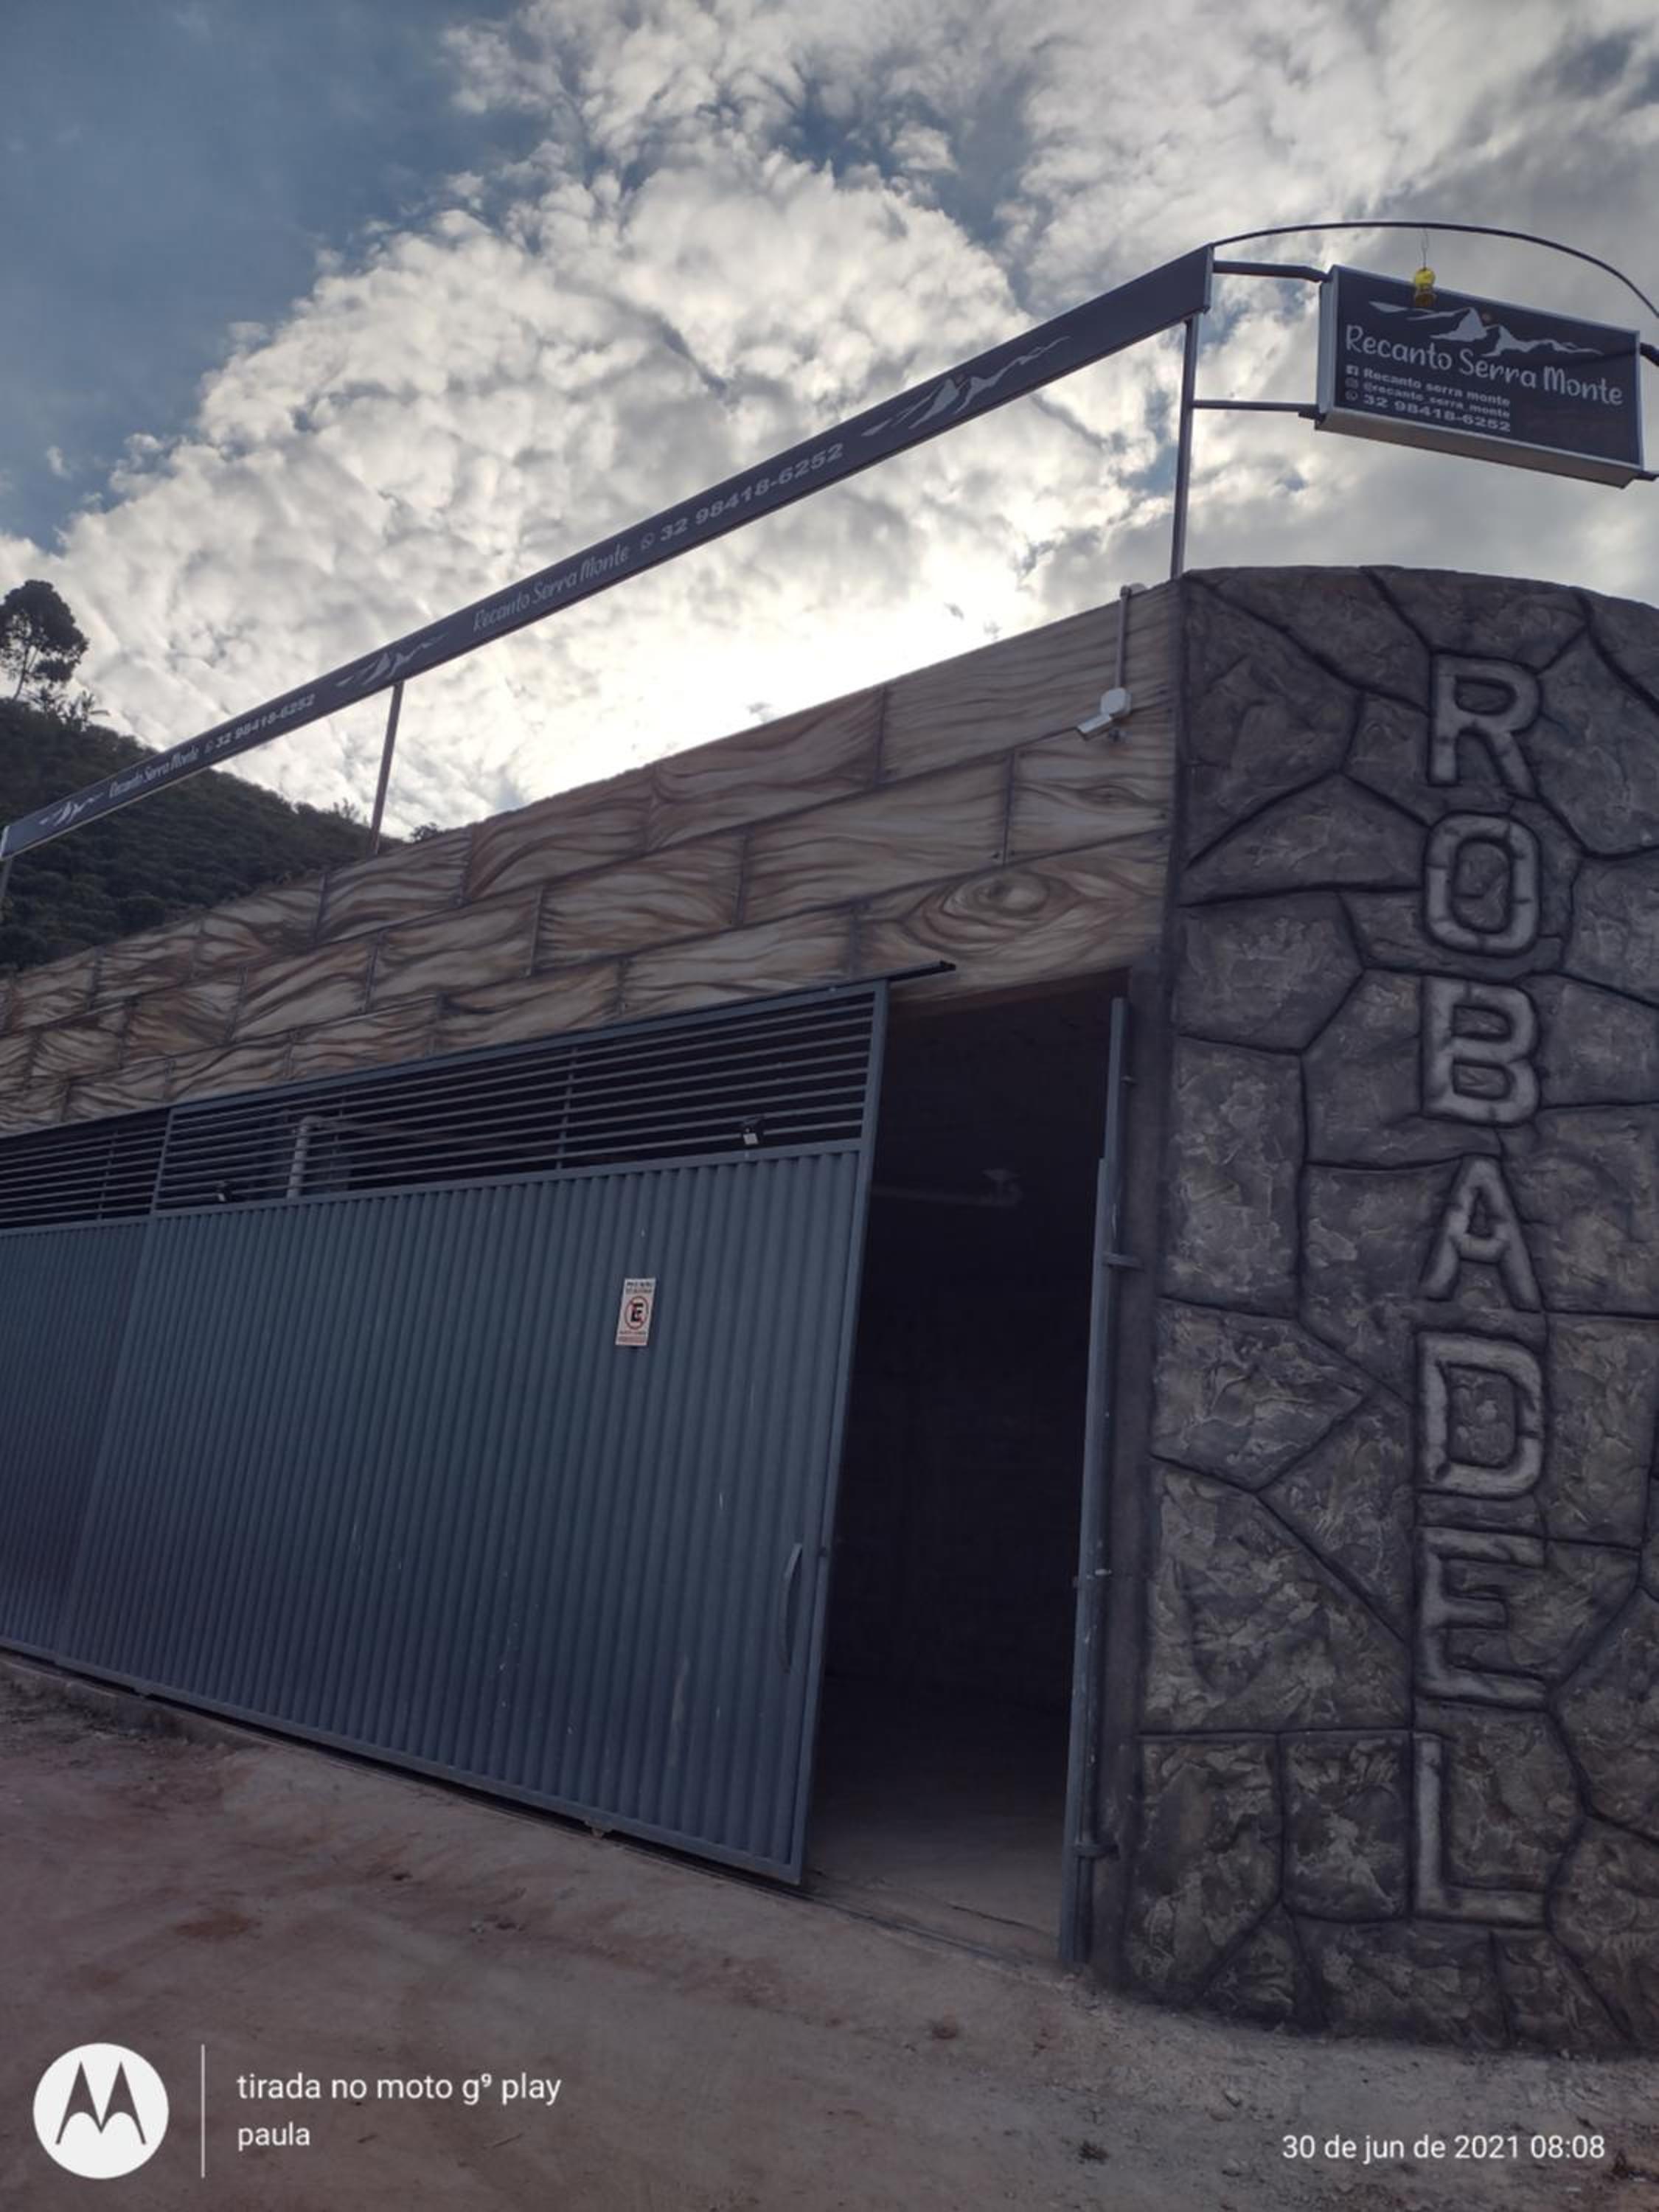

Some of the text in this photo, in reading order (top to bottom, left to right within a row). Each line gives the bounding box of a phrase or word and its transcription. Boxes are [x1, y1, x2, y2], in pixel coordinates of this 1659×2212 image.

[1345, 324, 1623, 406] Recanto Serra Monte
[1363, 368, 1422, 389] Recanto
[1467, 391, 1511, 406] monte
[1363, 394, 1511, 433] 32 98418-6252
[473, 442, 844, 631] Recanto Serra Monte 32 98418-6252
[1411, 650, 1551, 1928] ROBADEL
